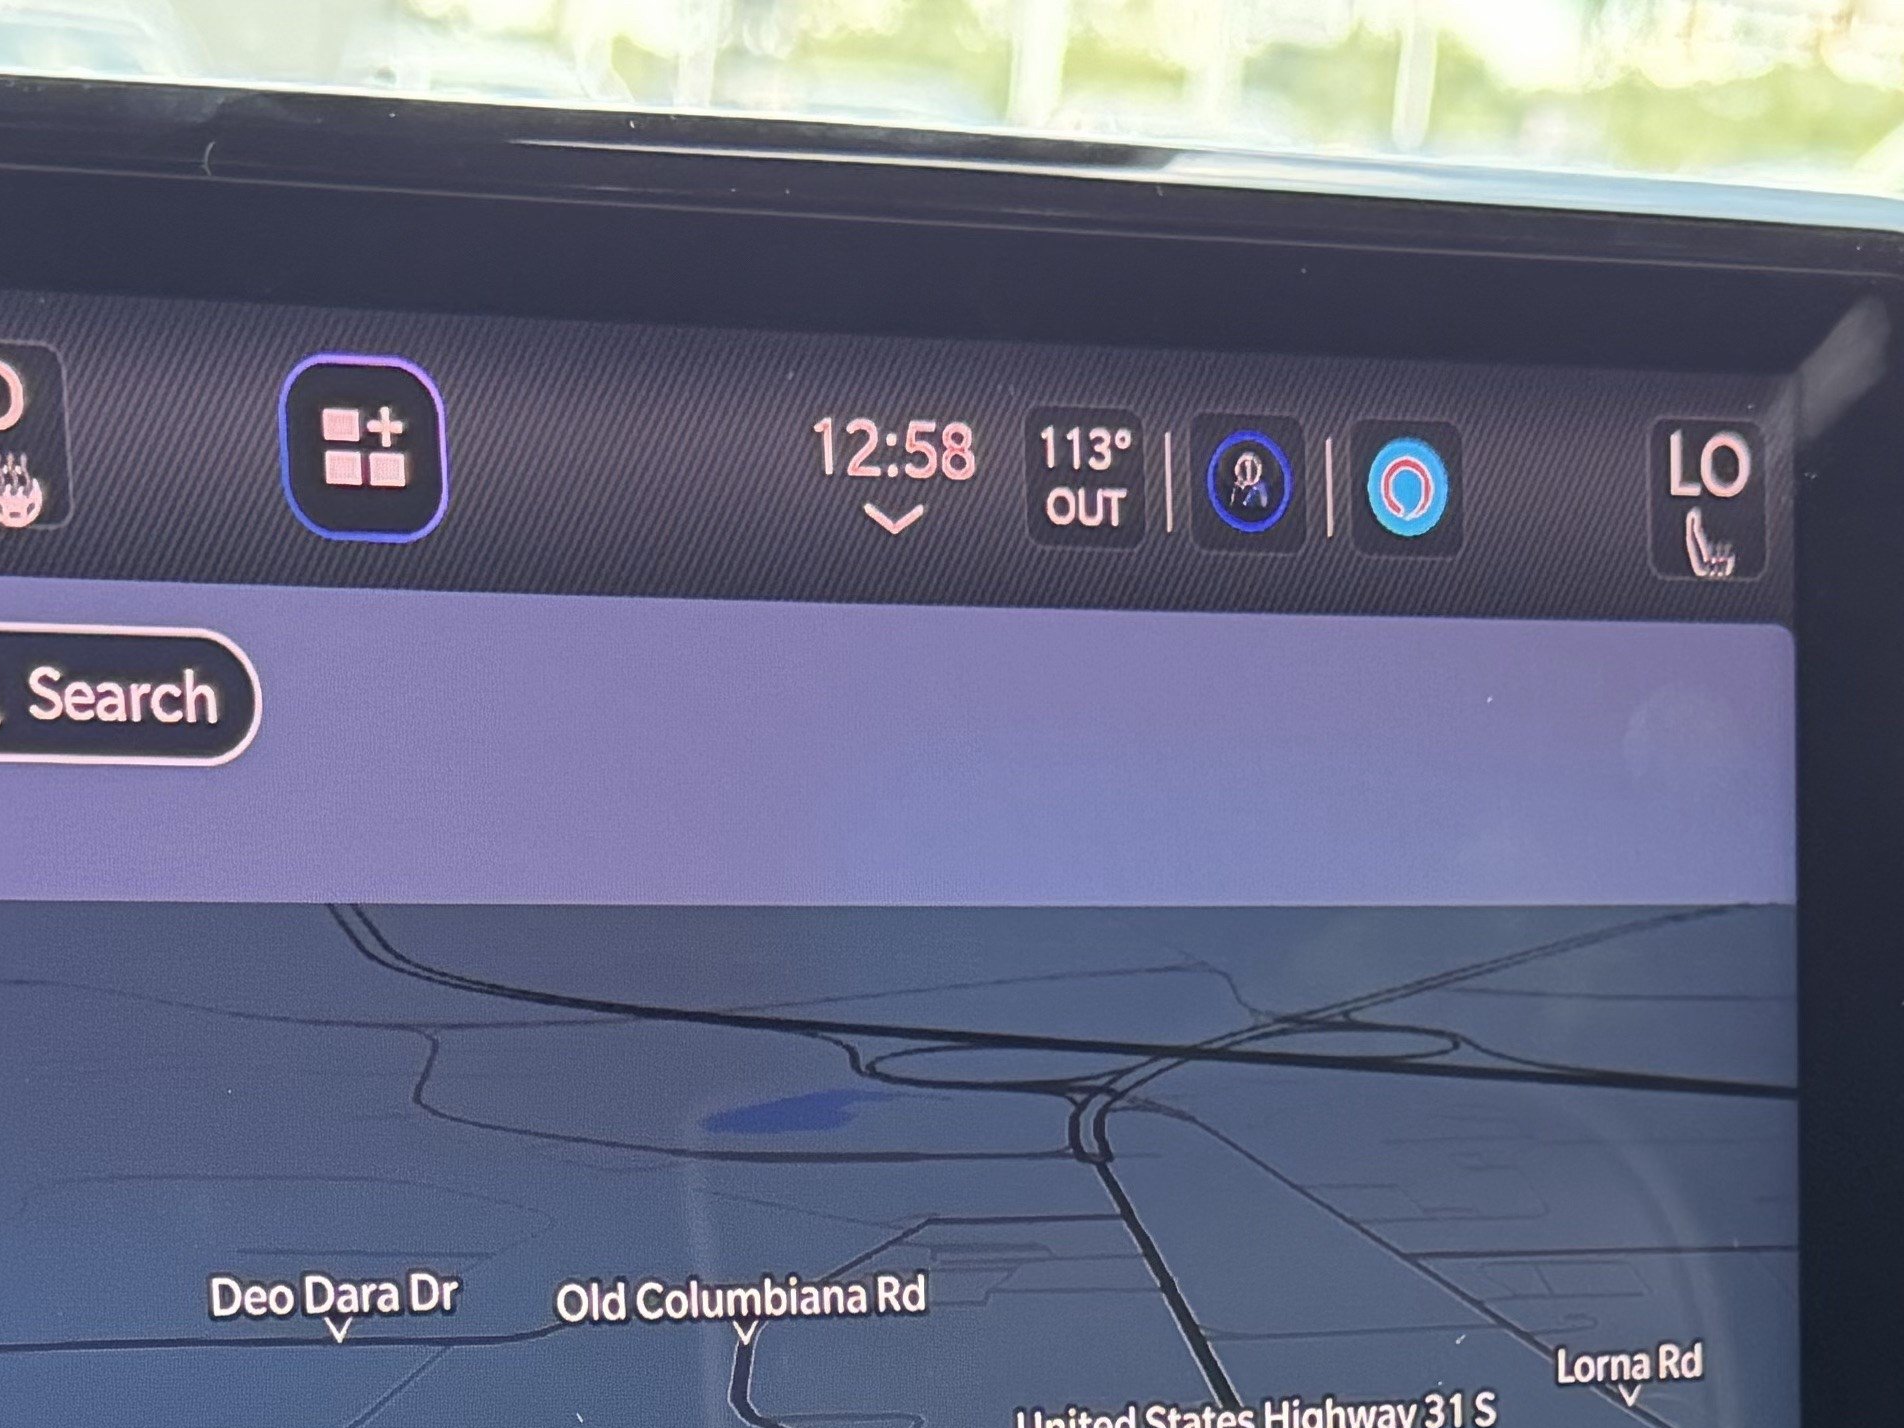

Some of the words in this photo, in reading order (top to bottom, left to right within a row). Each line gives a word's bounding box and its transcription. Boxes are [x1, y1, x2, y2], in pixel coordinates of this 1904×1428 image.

[813, 418, 976, 481] 12:58
[1041, 427, 1132, 473] 113°
[1670, 431, 1750, 498] LO
[1047, 489, 1126, 527] OUT
[28, 667, 219, 726] Search
[211, 1277, 294, 1320] Deo
[305, 1277, 399, 1316] Dara
[410, 1273, 460, 1312] Dr
[557, 1284, 626, 1323] Old
[637, 1276, 866, 1320] Columbiana
[876, 1273, 926, 1313] Rd
[1557, 1347, 1648, 1384] Lorna
[1658, 1344, 1702, 1379] Rd
[1473, 1394, 1497, 1427] S
